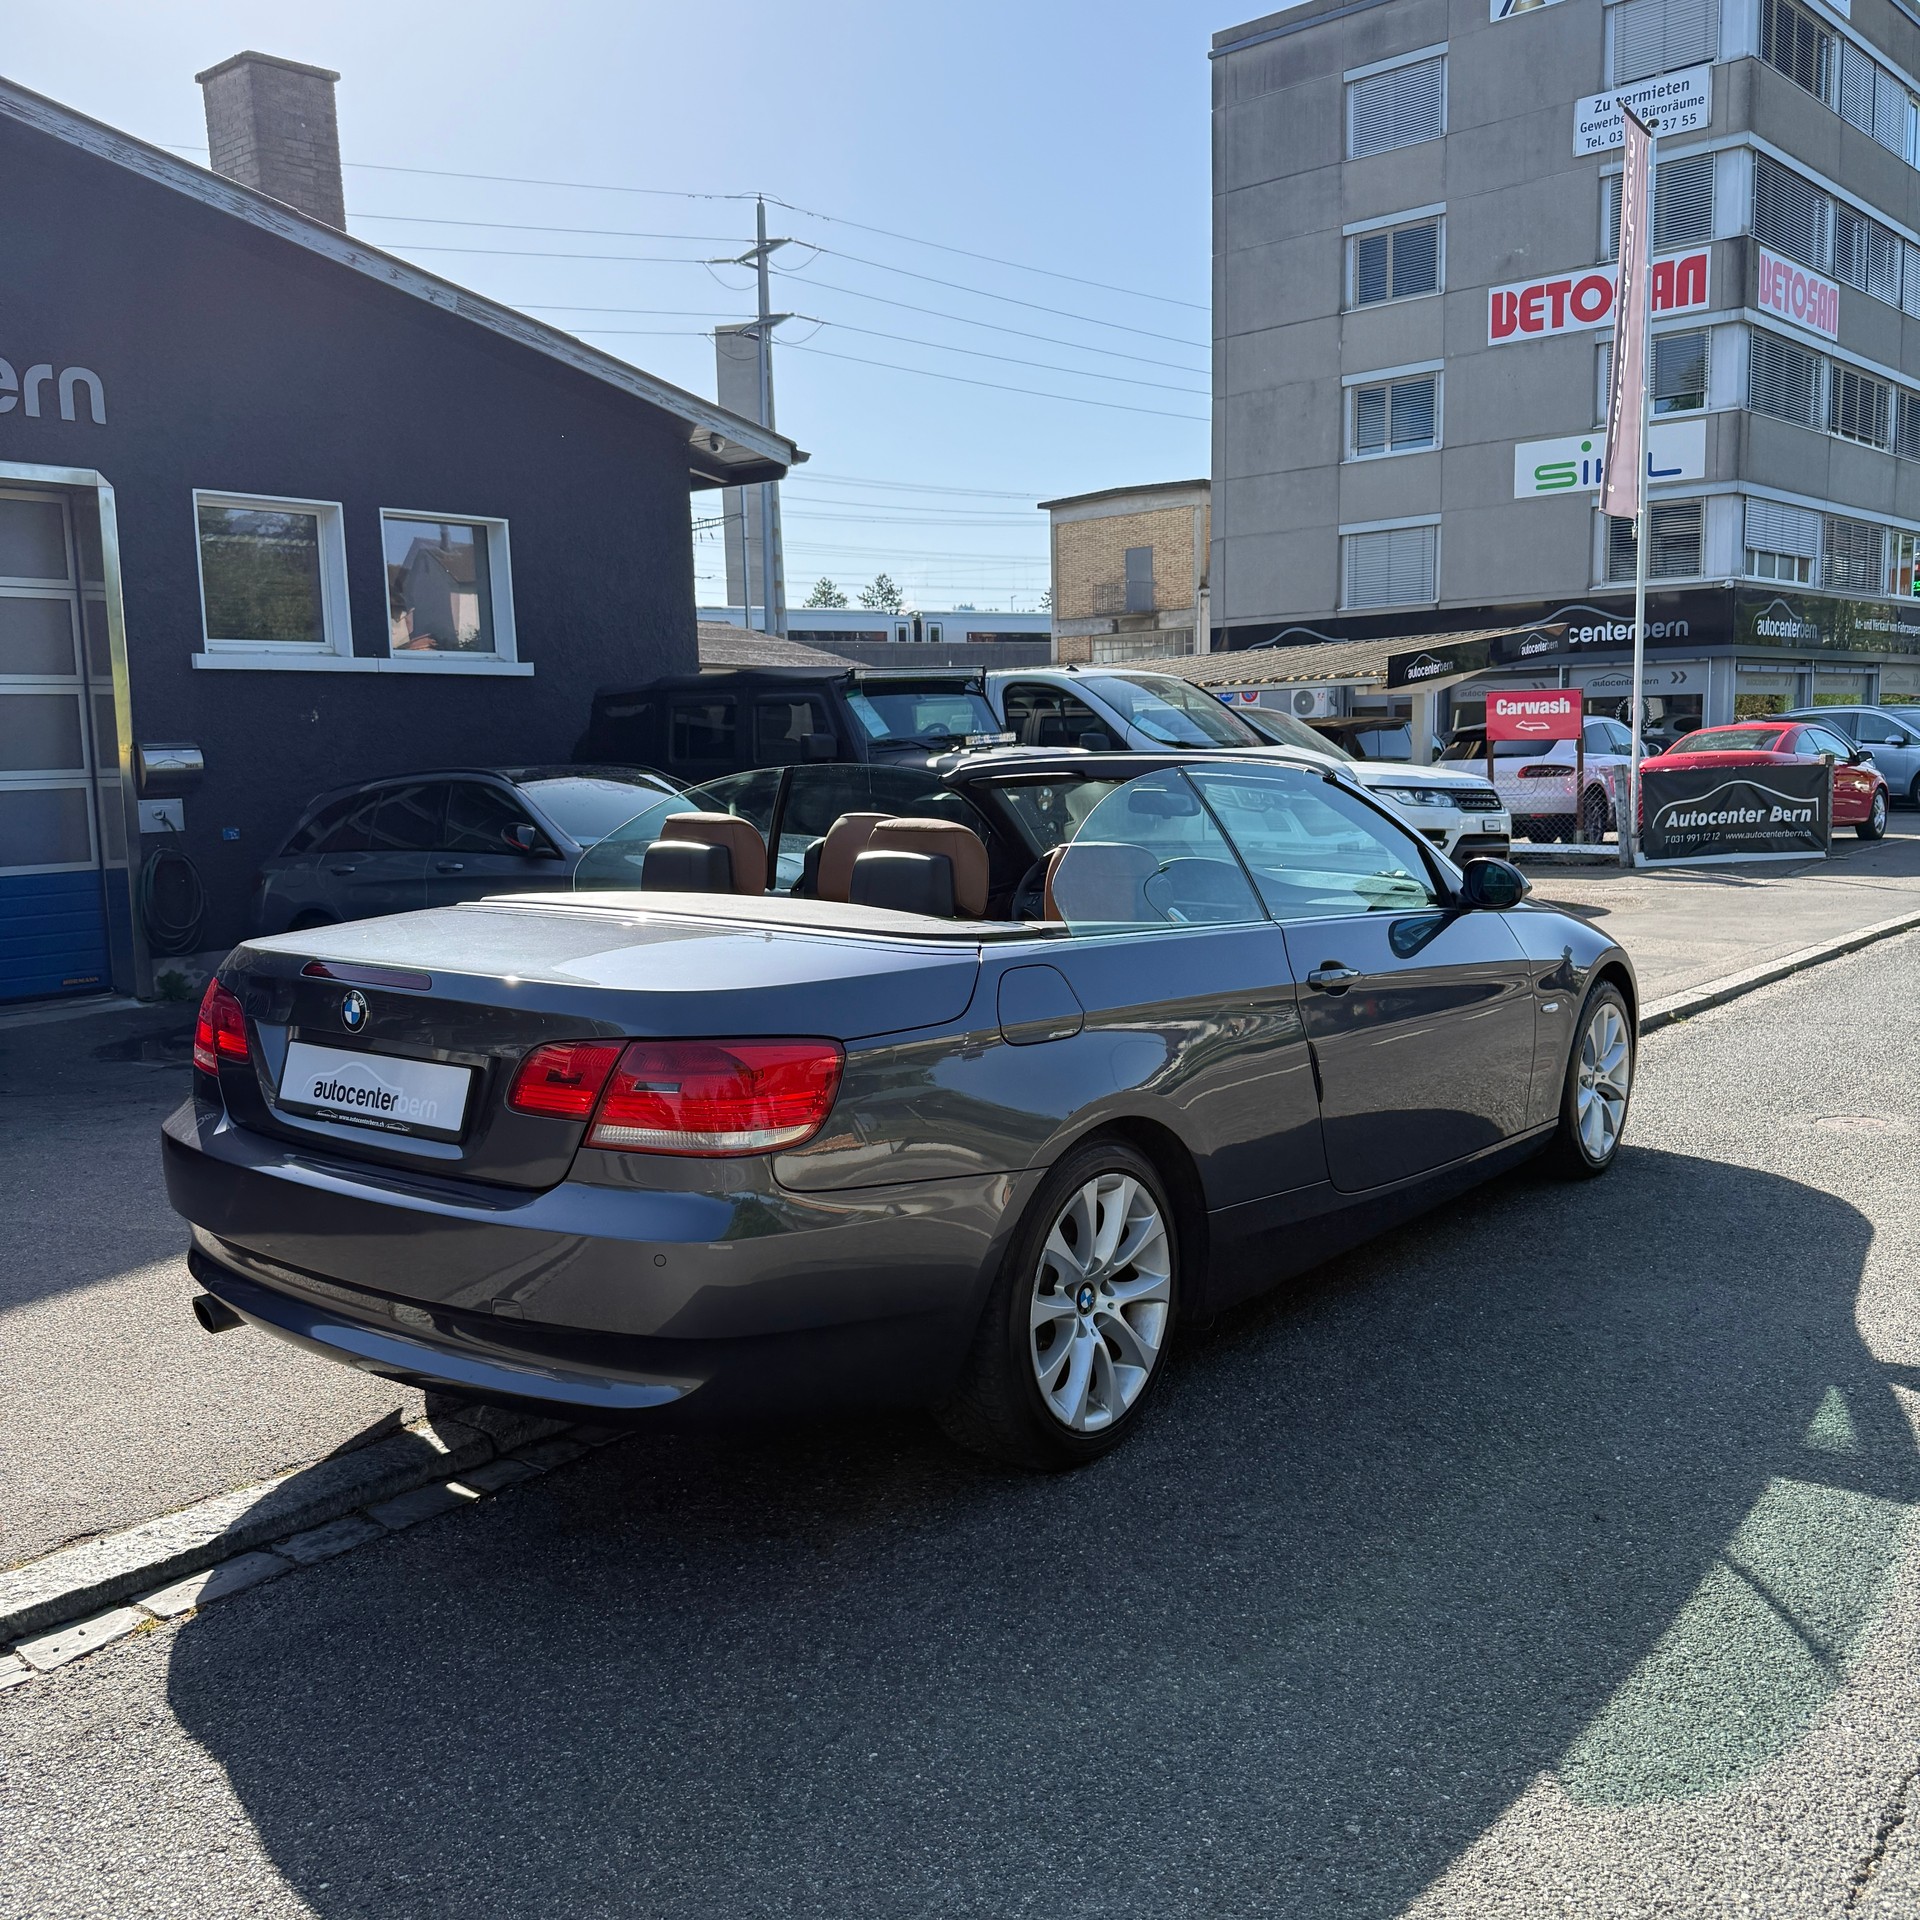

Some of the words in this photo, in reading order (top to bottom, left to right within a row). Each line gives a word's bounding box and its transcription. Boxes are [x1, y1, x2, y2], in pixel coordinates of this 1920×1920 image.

[1594, 100, 1611, 114] Zu
[1641, 95, 1705, 118] Büroräume
[1586, 135, 1605, 148] Tel.
[1682, 112, 1697, 127] 55
[1759, 254, 1838, 335] BETOSAN
[1756, 616, 1818, 639] autocenterbern
[1407, 661, 1454, 679] autocenterbern
[1496, 697, 1571, 716] Carwash
[1665, 807, 1766, 828] Autocenter
[1770, 805, 1812, 823] Bern
[1686, 833, 1700, 843] 991
[1725, 829, 1812, 840] www.autocenterbern.ch
[313, 1079, 437, 1119] autocenterbern
